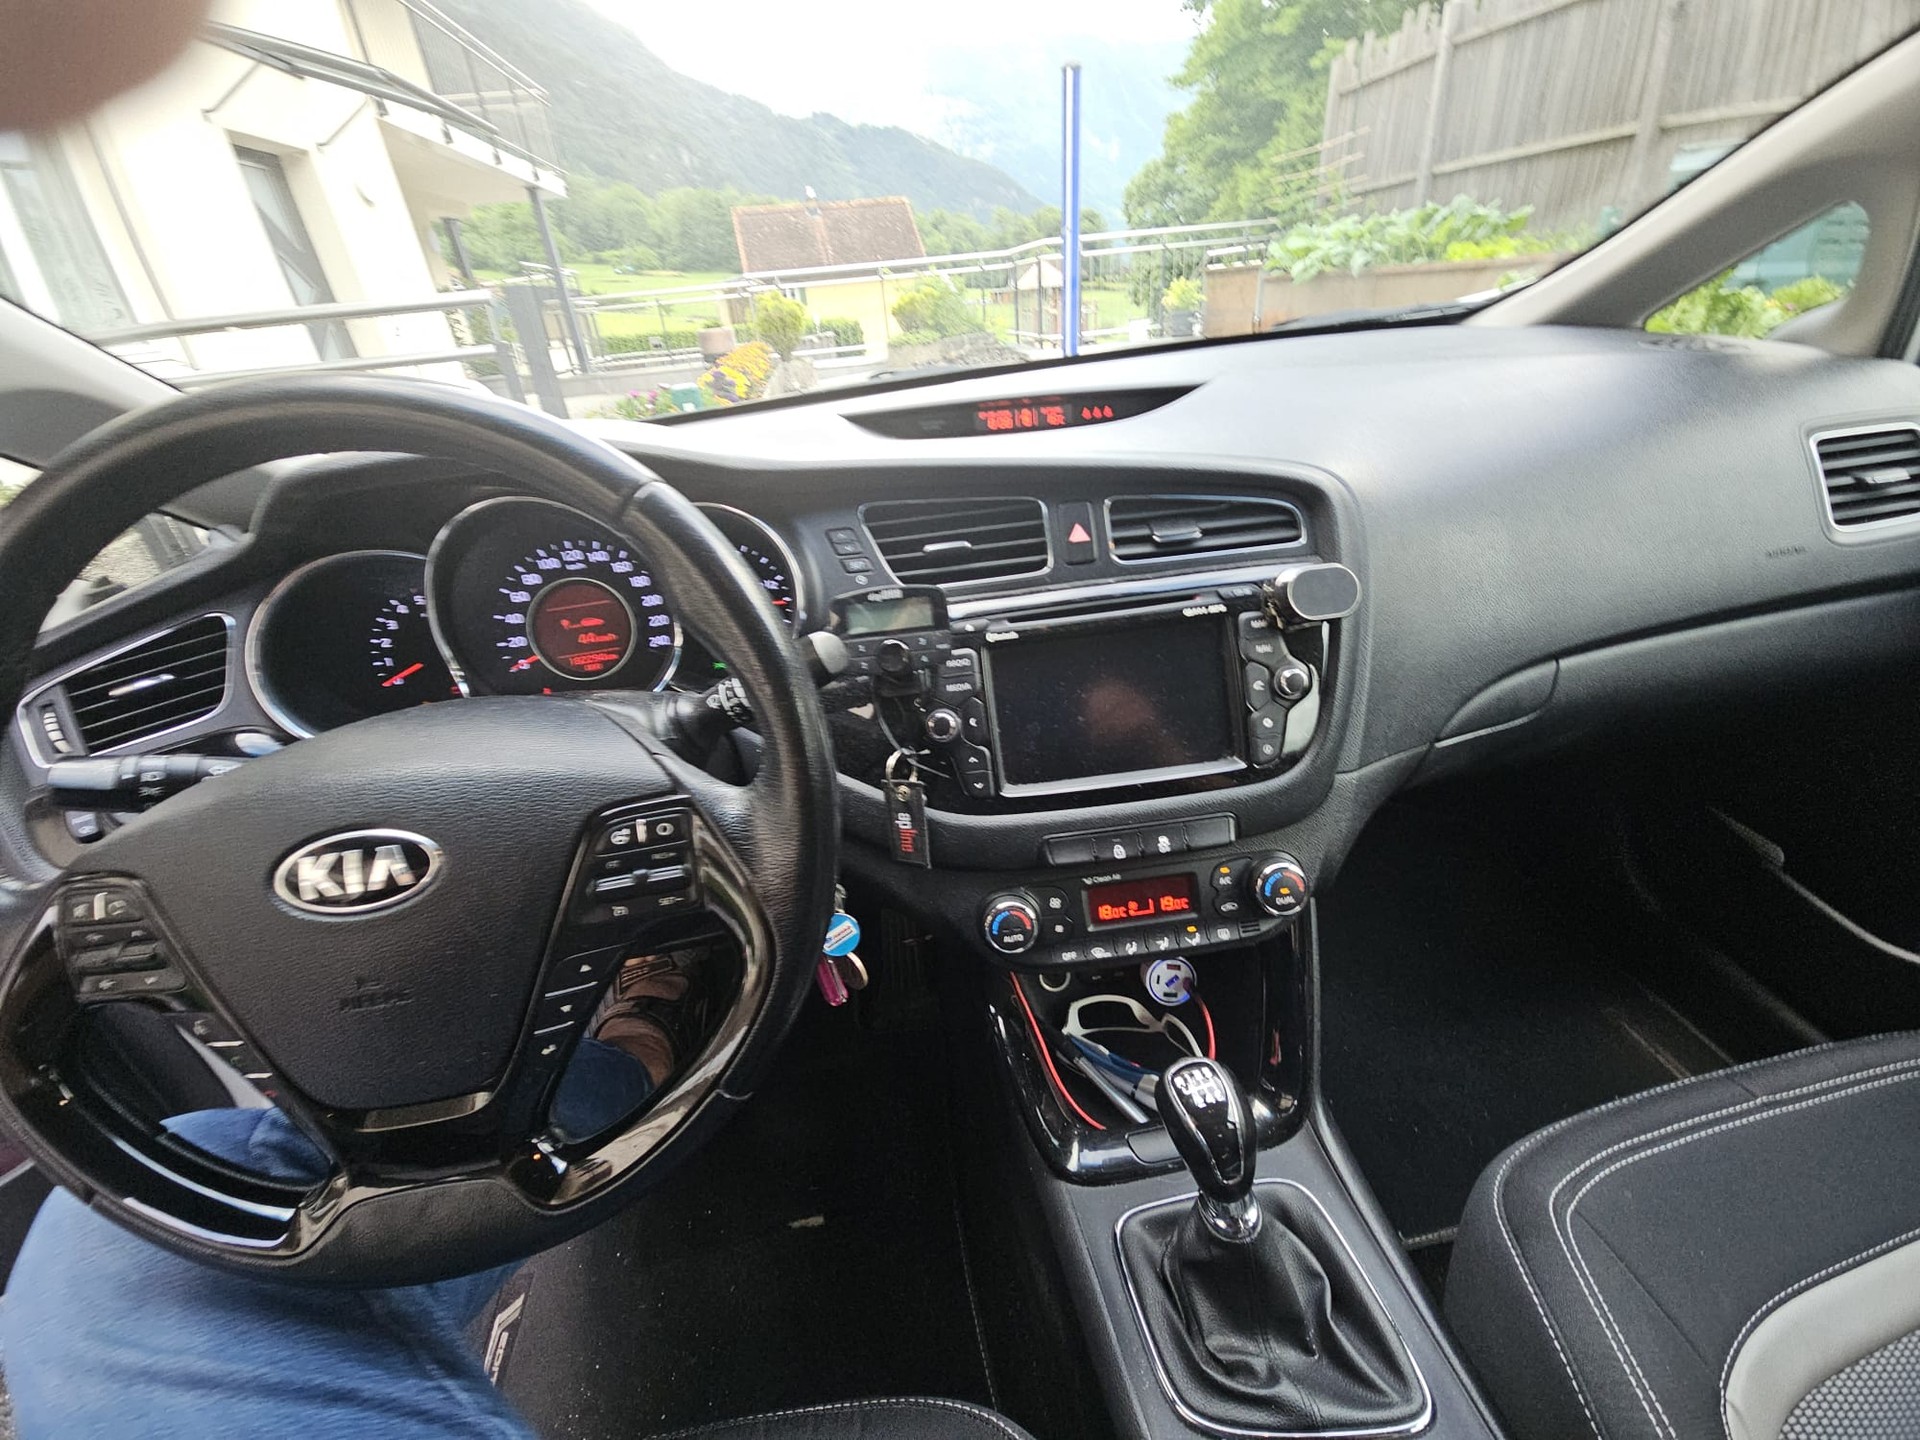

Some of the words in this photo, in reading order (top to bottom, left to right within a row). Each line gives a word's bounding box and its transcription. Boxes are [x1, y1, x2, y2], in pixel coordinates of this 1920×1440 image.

[297, 844, 418, 901] KIA
[1003, 933, 1025, 943] AUTO
[1061, 951, 1077, 961] OFF
